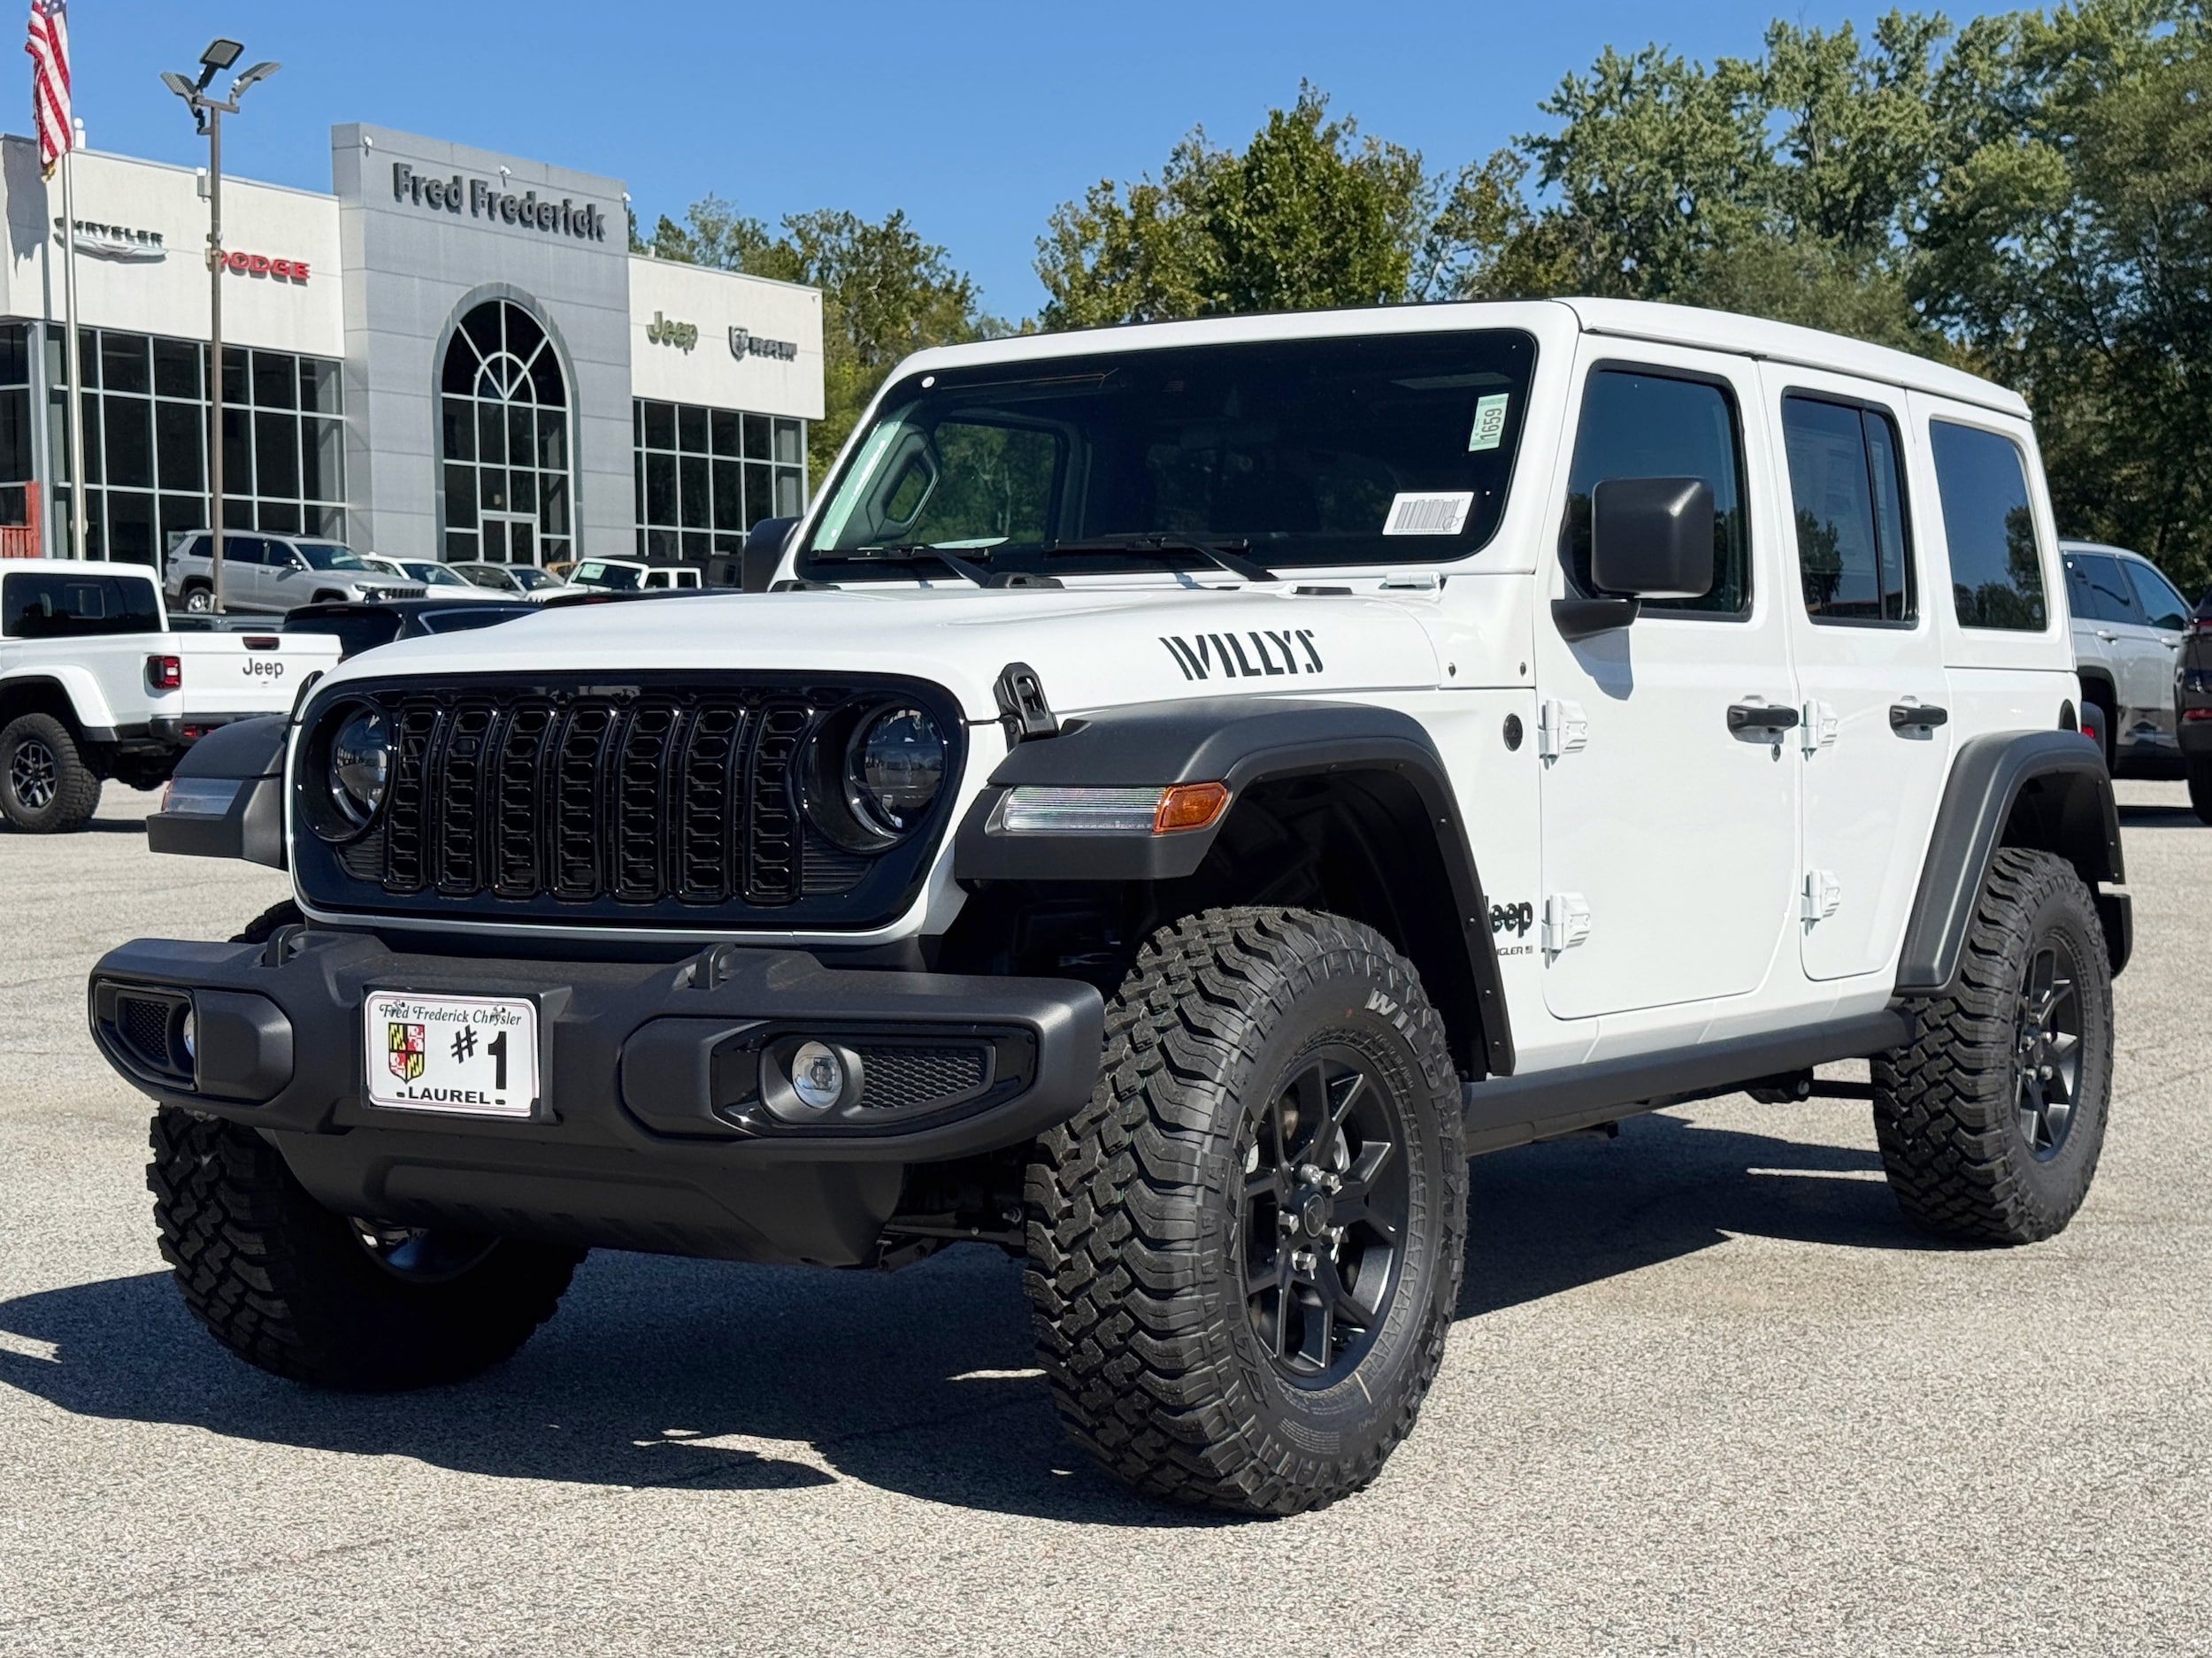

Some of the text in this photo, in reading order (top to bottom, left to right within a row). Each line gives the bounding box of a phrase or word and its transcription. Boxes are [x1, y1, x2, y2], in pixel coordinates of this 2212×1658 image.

[393, 163, 606, 237] Fred Frederick
[646, 311, 698, 351] Jeep
[1479, 408, 1502, 441] 1659
[242, 657, 284, 679] Jeep
[1158, 629, 1324, 680] WILLYS
[1483, 895, 1533, 939] eep
[380, 1003, 521, 1026] Fred Frederick Chrysler
